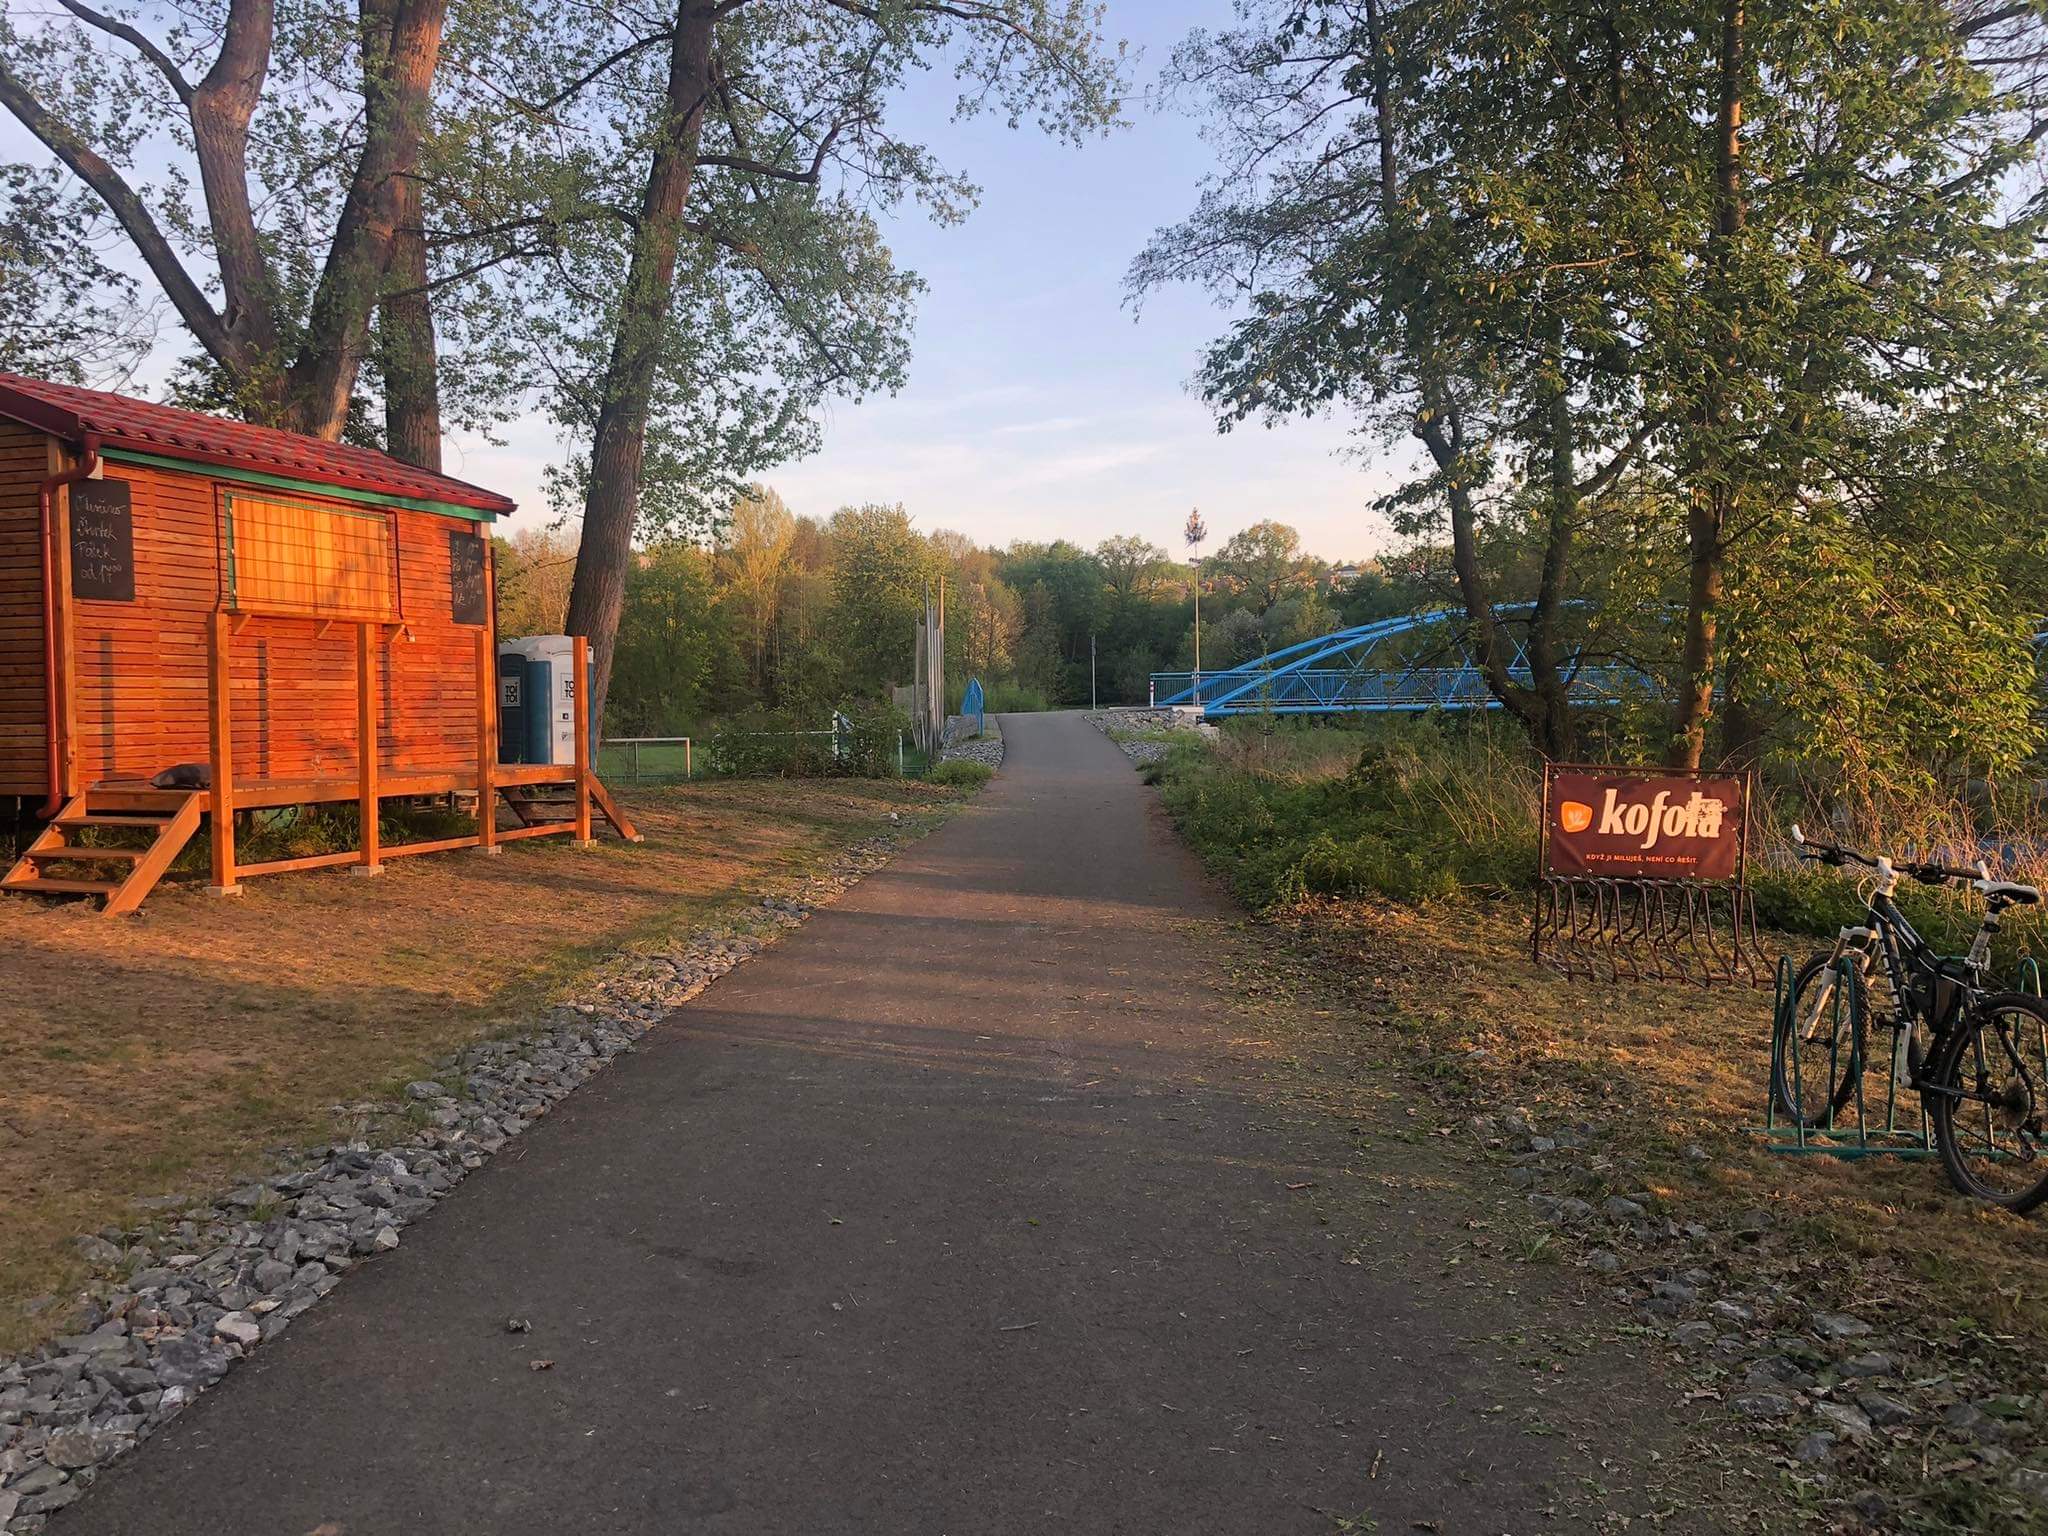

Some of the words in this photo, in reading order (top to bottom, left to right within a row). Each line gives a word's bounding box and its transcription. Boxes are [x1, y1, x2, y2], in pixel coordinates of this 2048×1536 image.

[1598, 788, 1723, 850] kofola
[1614, 854, 1644, 862] MILUJEŠ,
[1646, 855, 1663, 863] NENÍ
